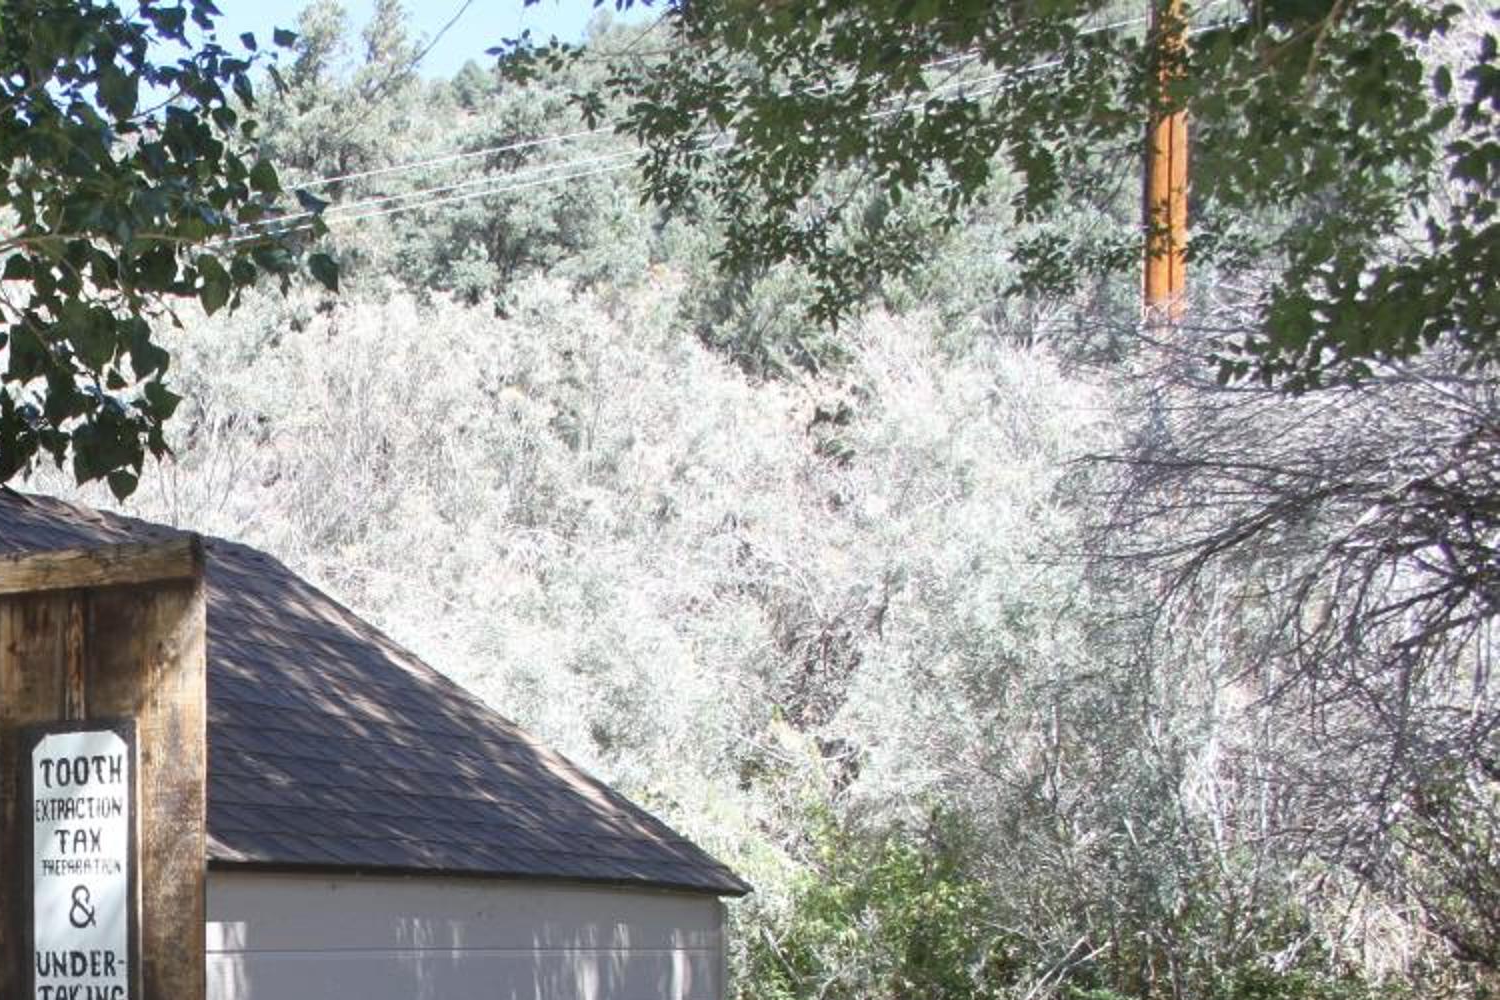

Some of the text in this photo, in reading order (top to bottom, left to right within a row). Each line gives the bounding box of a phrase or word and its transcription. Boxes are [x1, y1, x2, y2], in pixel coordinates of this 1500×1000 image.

[40, 755, 122, 788] TOOTH
[35, 797, 122, 821] EXTRACTION
[54, 828, 102, 854] TAX
[69, 884, 97, 928] &
[36, 951, 125, 978] UNDER-
